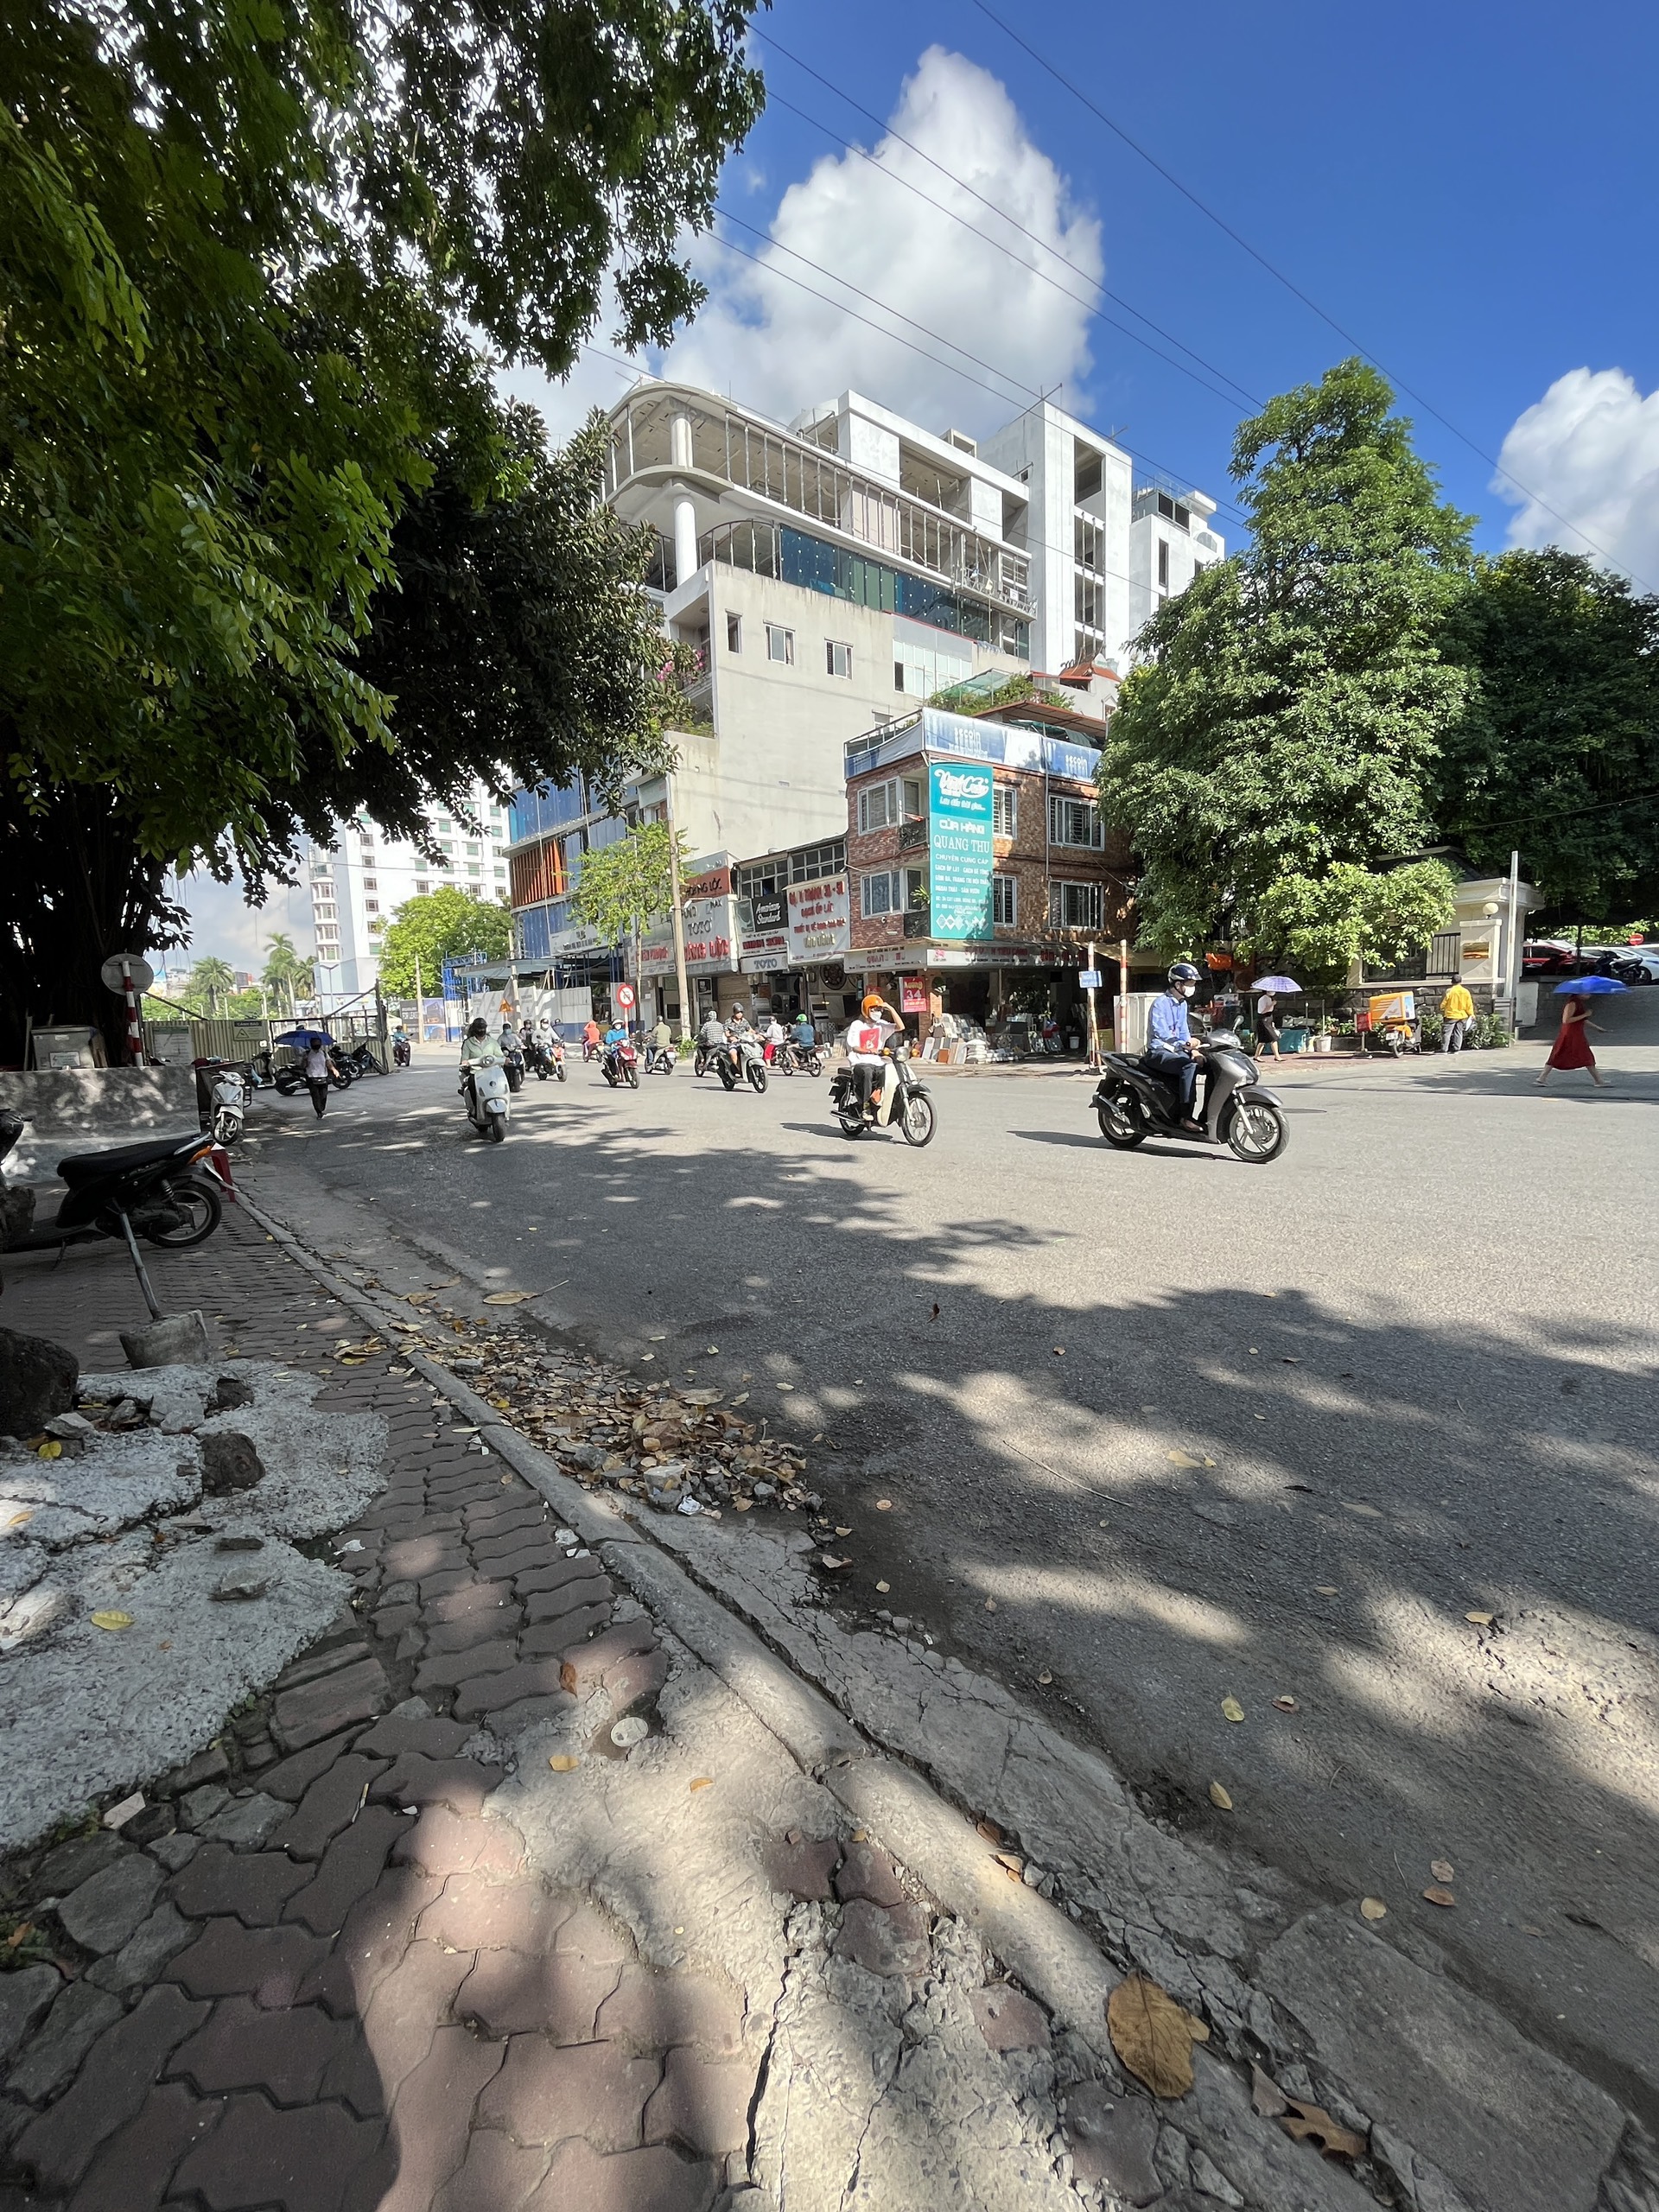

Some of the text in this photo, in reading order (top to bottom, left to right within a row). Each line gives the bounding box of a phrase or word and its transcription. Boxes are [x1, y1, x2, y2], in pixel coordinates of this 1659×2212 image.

[954, 728, 981, 740] secoin
[1065, 754, 1087, 766] secoin
[961, 821, 985, 835] HÀNG
[933, 835, 990, 854] QUANG THU
[756, 902, 781, 914] American
[757, 911, 781, 925] Standard
[688, 919, 712, 936] TOTO
[753, 958, 778, 969] TOTO
[907, 990, 921, 1001] 34
